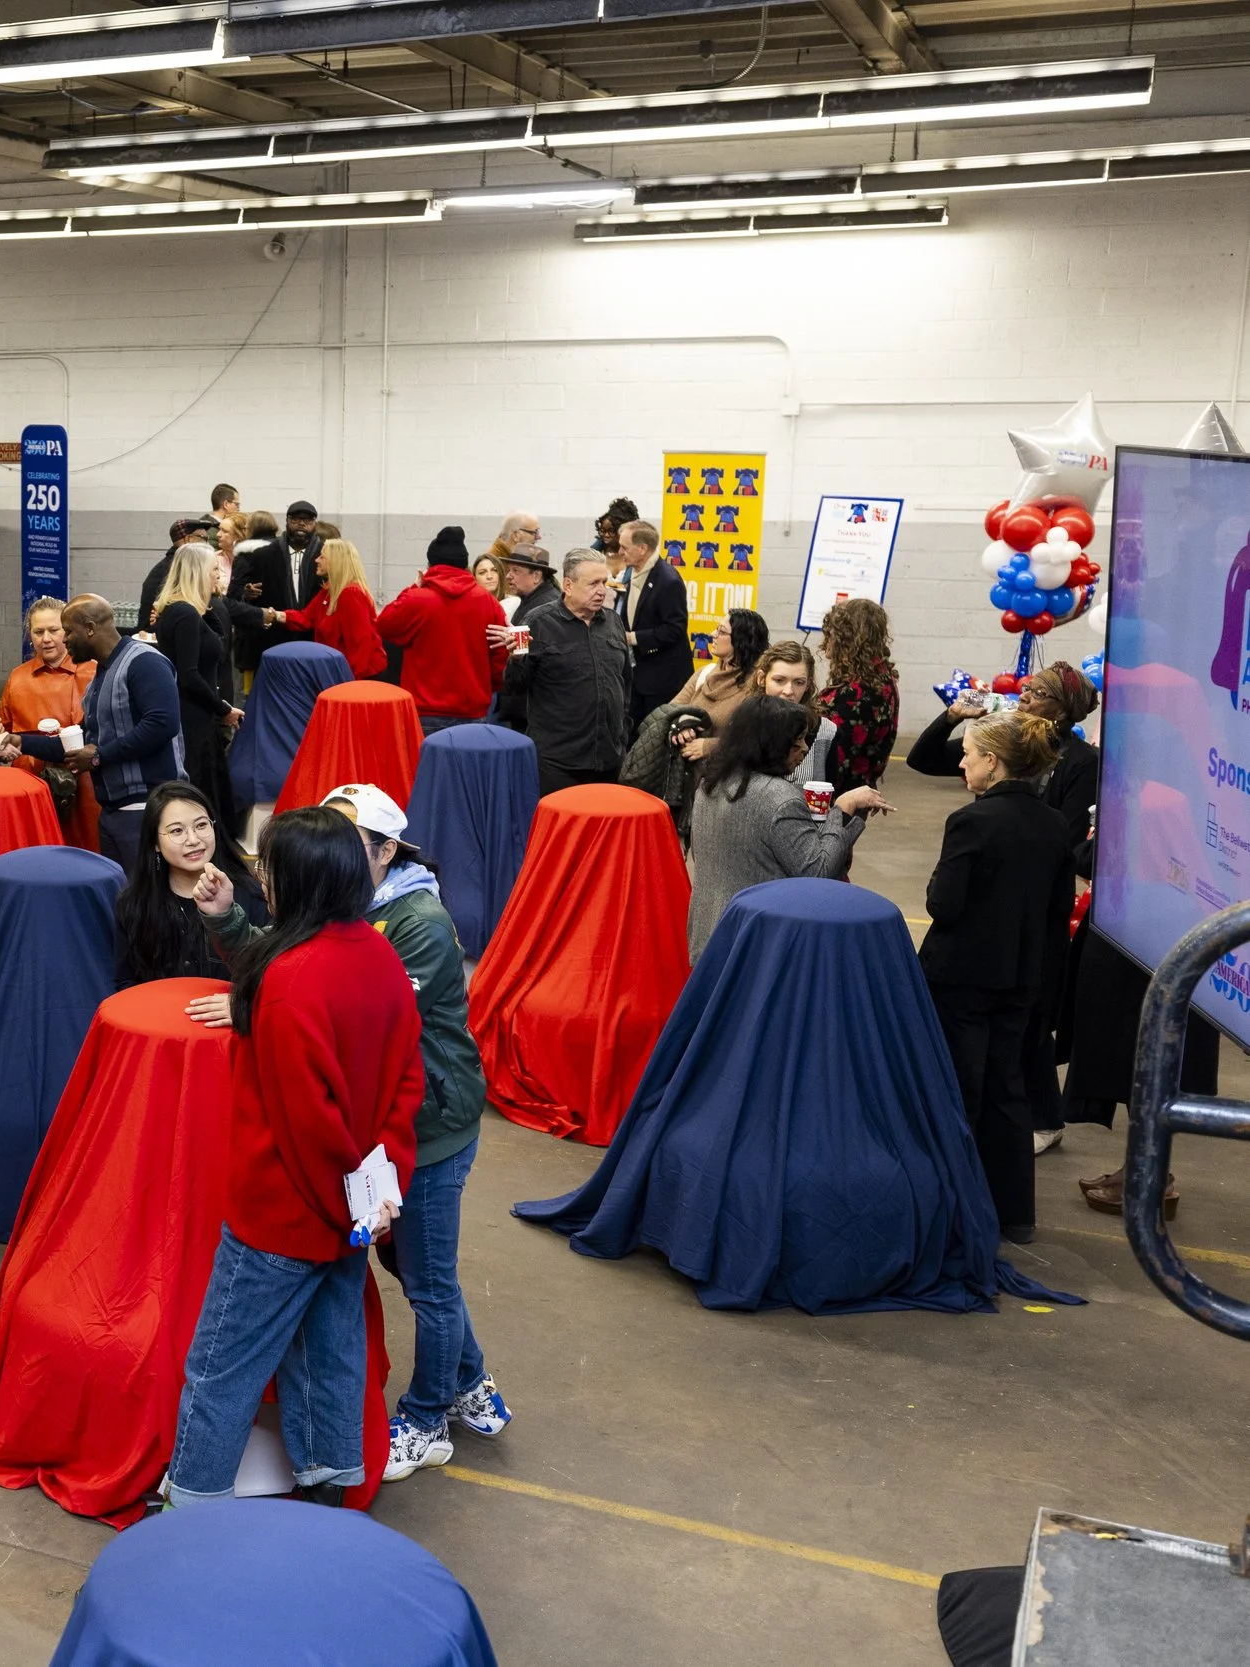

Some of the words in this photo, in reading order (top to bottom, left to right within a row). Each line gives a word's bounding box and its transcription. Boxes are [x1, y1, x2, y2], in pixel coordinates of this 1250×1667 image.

[46, 440, 63, 456] PA
[1088, 455, 1108, 471] PA
[27, 472, 60, 480] CELEBRATING
[26, 483, 60, 512] 250
[27, 515, 61, 531] YEARS
[703, 581, 724, 615] IT
[1220, 826, 1230, 841] The
